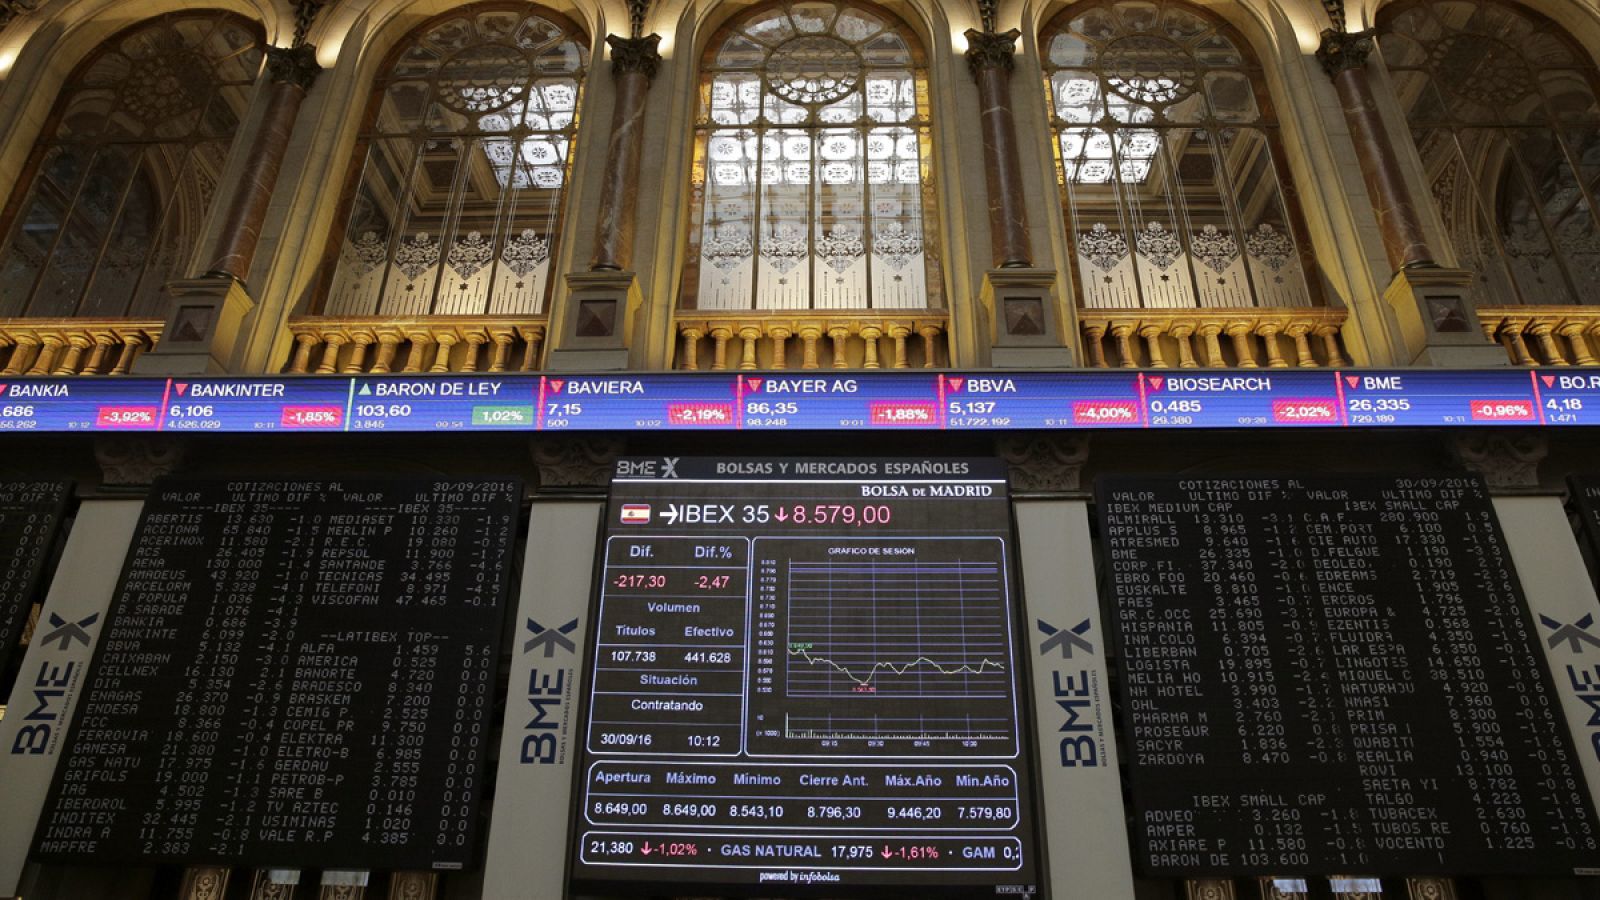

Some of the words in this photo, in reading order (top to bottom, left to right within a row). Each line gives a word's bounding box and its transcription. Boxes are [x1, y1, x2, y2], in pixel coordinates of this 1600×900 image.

[375, 383, 436, 396] BARON
[440, 382, 464, 396] DE
[468, 382, 502, 396] LEY
[568, 380, 645, 394] BAVIERA
[766, 379, 828, 393] BAYER
[831, 379, 858, 393] AG
[967, 379, 1016, 393] BBVA
[1167, 377, 1271, 392] BIOSEARCH
[1363, 376, 1403, 390] BME
[9, 384, 69, 397] BANKIA
[191, 383, 285, 397] BANKINTER
[547, 403, 582, 417] 7,15
[676, 408, 726, 421] -2,19%
[747, 402, 798, 415] 86,35
[878, 408, 929, 421] -1,88%
[949, 401, 996, 416] 5,137
[1079, 407, 1132, 420] -4,00%
[1151, 400, 1202, 414] 0,485
[1279, 406, 1331, 418] -2,02%
[1349, 398, 1410, 412] 26,335
[1476, 405, 1529, 417] -0,96%
[1546, 399, 1583, 412] 4,18
[104, 411, 151, 423] -3,92%
[170, 405, 213, 418] 6,106
[289, 410, 336, 423] -1,85%
[355, 404, 412, 418] 103,60
[482, 410, 524, 422] 1,02%
[547, 418, 569, 428] 500
[616, 460, 657, 476] BME
[716, 462, 773, 474] BOLSAS
[778, 462, 790, 474] Y
[795, 462, 878, 474] MERCADOS
[884, 460, 970, 475] ESPAÑOLES
[226, 481, 322, 492] COTIZACIONES
[329, 482, 345, 492] AL
[433, 482, 514, 492] 30/09/2016
[861, 484, 909, 497] BOLSA
[928, 484, 992, 497] MADRID
[1179, 479, 1281, 490] COTIZACIONES
[1287, 480, 1305, 490] AL
[1395, 478, 1480, 489] 30/09/2016
[161, 492, 202, 502] VALOR
[231, 492, 280, 502] ULTIMO
[287, 492, 311, 502] DIF
[1112, 491, 1156, 502] VALOR
[1189, 491, 1240, 501] ULTIMO
[1248, 491, 1273, 501] DIF
[1107, 503, 1140, 513] IBEX
[1148, 503, 1200, 513] MEDIUM
[1207, 502, 1233, 512] CAP
[329, 515, 395, 525] MEDIASET
[679, 504, 736, 524] IBEX
[742, 504, 770, 524] 35
[792, 505, 891, 527] 8.579,00
[1107, 514, 1176, 525] ALMIRALL
[321, 549, 371, 559] REPSOL
[629, 545, 654, 558] Dif.
[828, 547, 867, 556] GRAFICO
[868, 547, 881, 556] DE
[1111, 549, 1138, 560] BME
[318, 571, 384, 582] TECNICAS
[613, 575, 666, 589] -217,30
[693, 575, 730, 590] -2,47
[1116, 584, 1188, 596] EUSKALTE
[311, 595, 381, 605] VISCOFAN
[647, 602, 701, 613] Volumen
[684, 626, 735, 637] Efectivo
[611, 651, 657, 662] 107.738
[684, 652, 732, 663] 441.628
[1126, 660, 1191, 671] LOGISTA
[295, 668, 356, 680] BANORTE
[639, 673, 698, 686] Situación
[11, 661, 75, 755] BME
[86, 703, 139, 715] ENDESA
[631, 699, 704, 711] Contratando
[519, 668, 565, 765] BME
[1051, 670, 1098, 768] BME
[1134, 726, 1210, 738] PROSEGUR
[600, 733, 652, 746] 30/09/16
[687, 735, 721, 747] 10:12
[595, 771, 651, 785] Apertura
[666, 772, 717, 785] Máximo
[799, 774, 839, 787] Cierre
[842, 774, 869, 787] Ant.
[885, 774, 942, 787] Máx.Año
[594, 802, 647, 817] 8.649,00
[662, 804, 717, 818] 8.649,00
[729, 805, 784, 820] 8.543,10
[807, 805, 861, 820] 8.796,30
[887, 807, 942, 821] 9.446,20
[957, 807, 1012, 821] 7.579,80
[262, 815, 337, 829] USIMINAS
[1147, 824, 1196, 838] AMPER
[591, 841, 634, 855] 21,380
[653, 843, 698, 857] -1,02%
[720, 844, 751, 857] GAS
[755, 844, 822, 858] NATURAL
[831, 845, 874, 860] 17,975
[894, 846, 940, 860] -1,61%
[962, 846, 996, 859] GAM
[1151, 854, 1201, 867] BARON
[1210, 854, 1230, 867] DE
[790, 870, 799, 884] by
